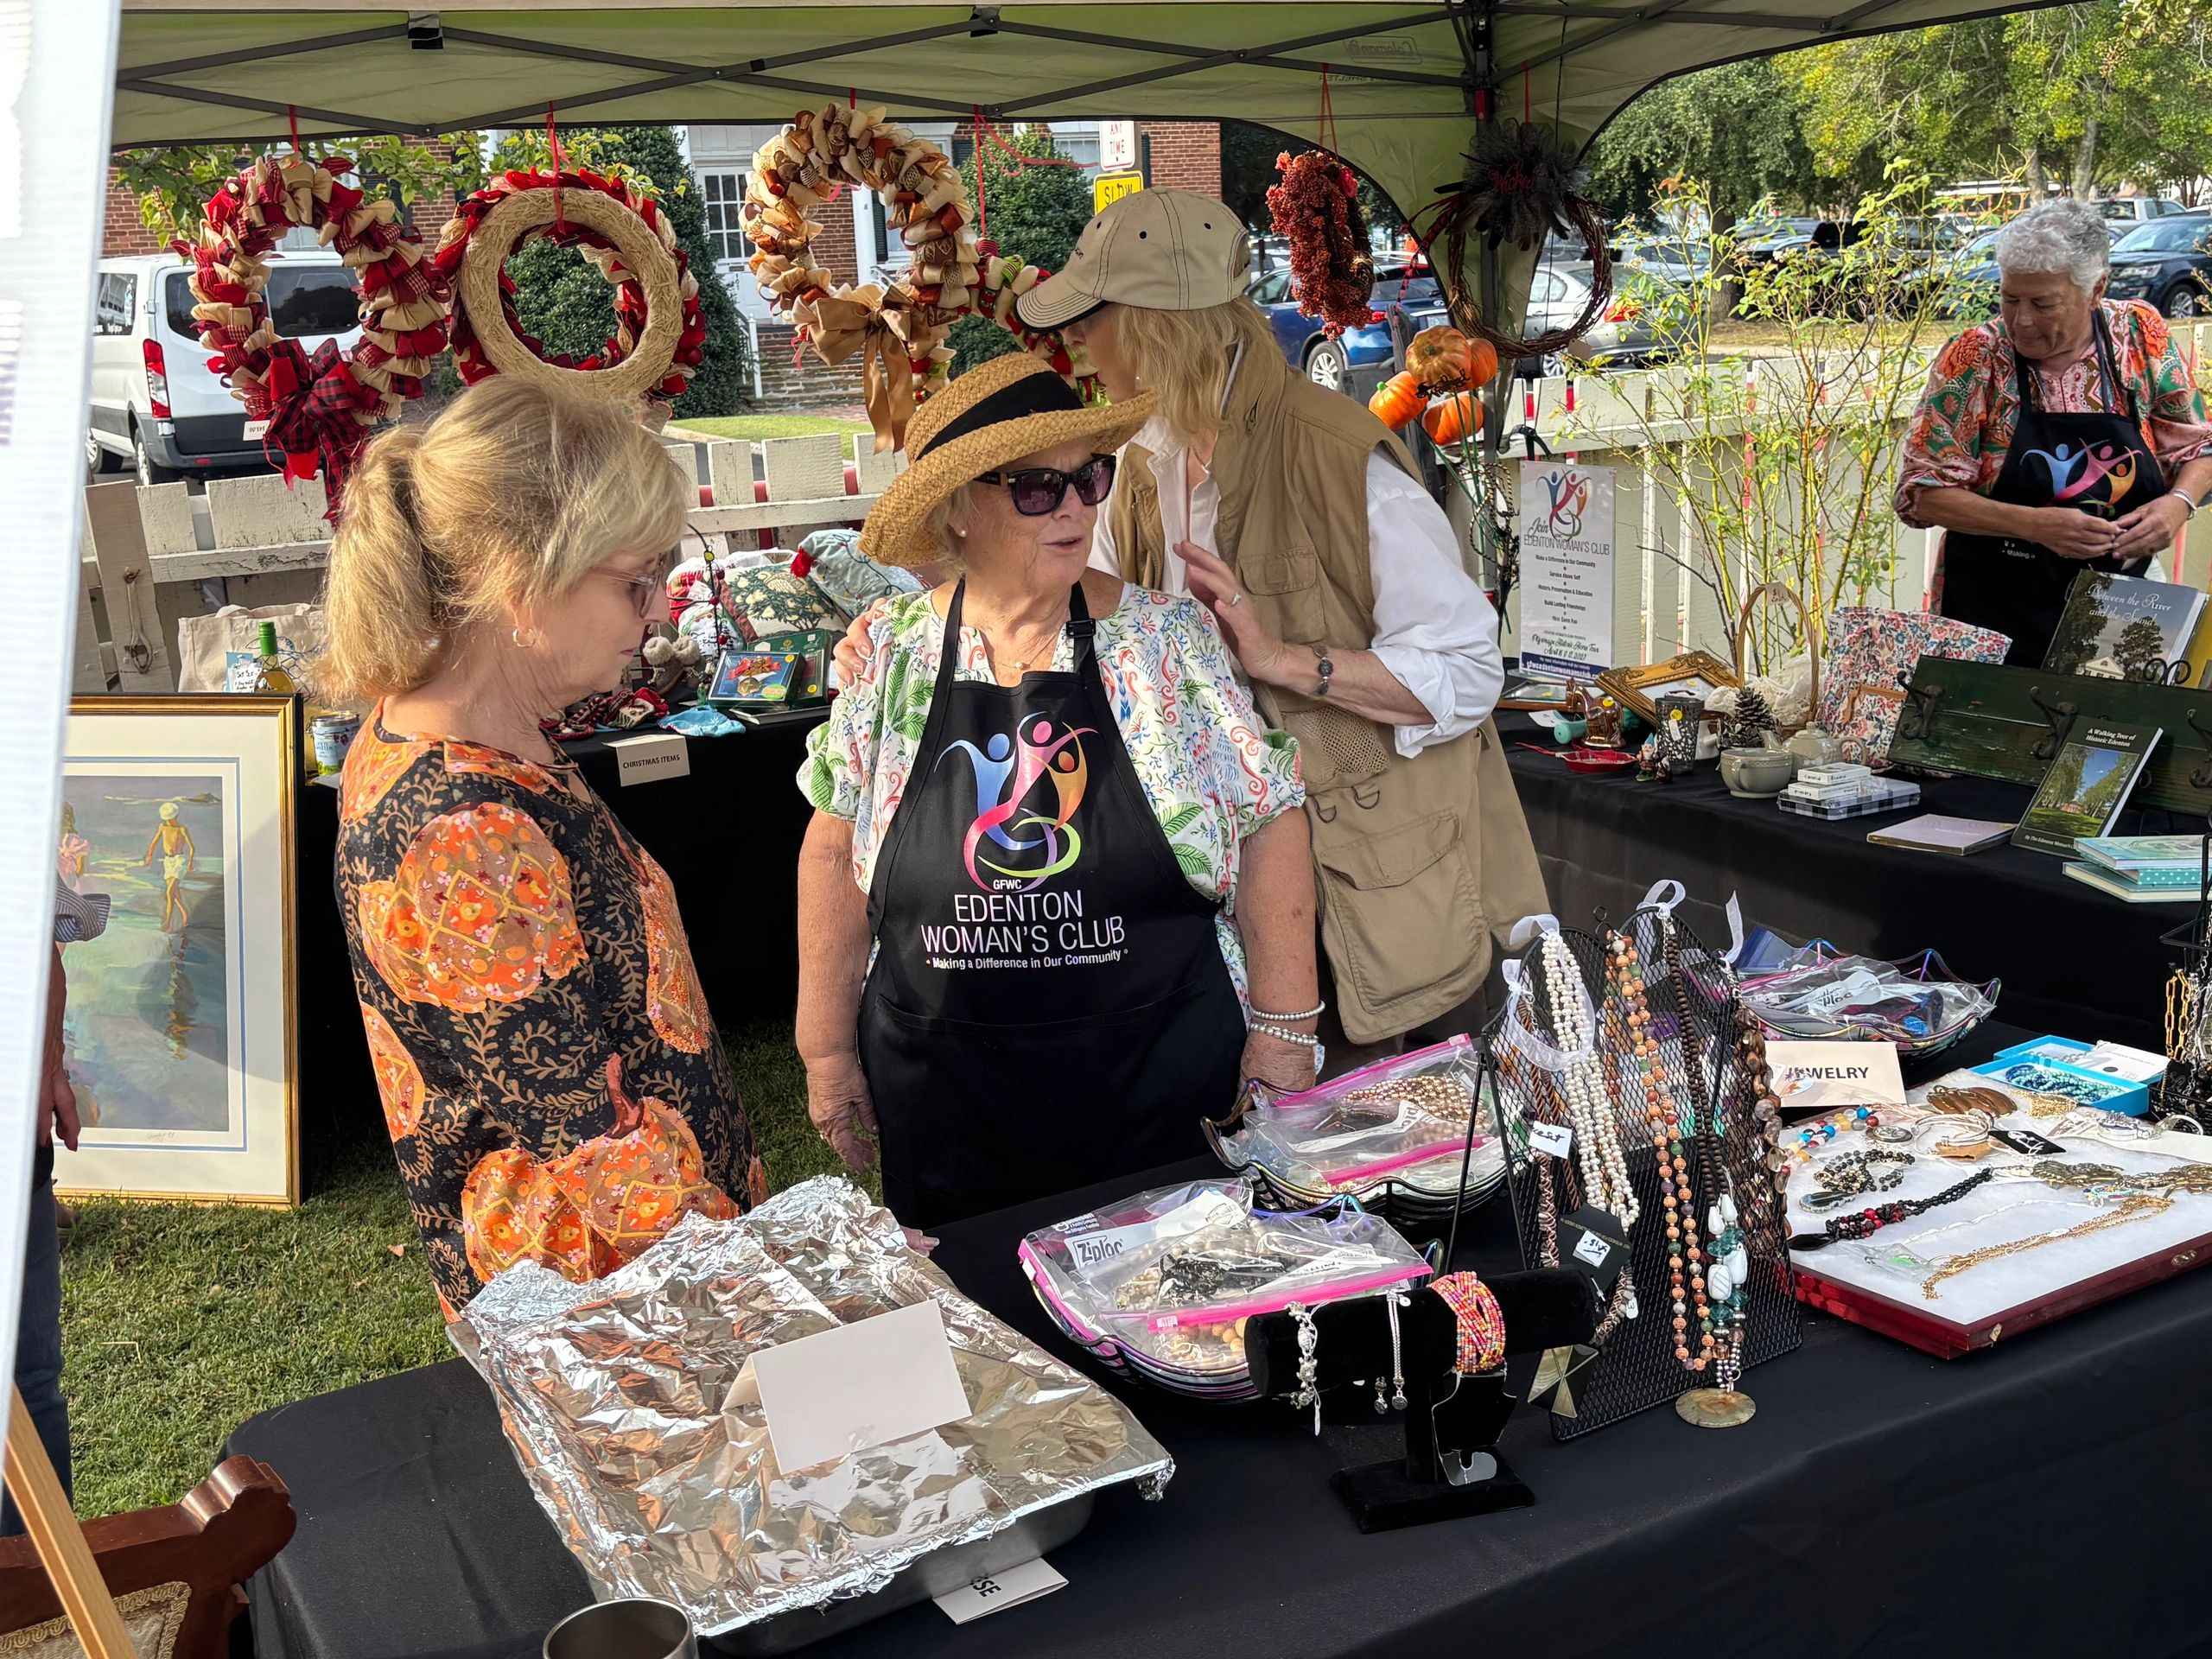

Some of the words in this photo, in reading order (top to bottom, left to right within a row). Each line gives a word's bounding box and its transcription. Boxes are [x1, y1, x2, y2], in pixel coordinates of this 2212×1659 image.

[1109, 139, 1125, 155] TIME
[1528, 517, 1548, 536] Join
[1523, 535, 1554, 549] EDENTON
[1555, 537, 1590, 553] WOMAN'S
[1591, 542, 1610, 555] CLUB
[2085, 583, 2125, 604] Between
[2126, 592, 2139, 606] the
[2141, 594, 2171, 611] River
[2089, 605, 2106, 616] and
[2107, 606, 2120, 619] the
[2122, 608, 2158, 626] Sound
[2086, 735, 2107, 744] Historic
[2107, 739, 2130, 747] Edenton
[2094, 729, 2116, 739] Walking
[623, 757, 660, 769] CHRISTMAS
[660, 754, 680, 764] ITEMS
[993, 880, 1022, 890] GFWC
[954, 890, 1083, 922] EDENTON
[921, 925, 1049, 953] WOMAN'S
[1058, 916, 1125, 950] CLUB
[932, 957, 966, 970] Making
[976, 957, 1028, 969] Difference
[1031, 957, 1040, 969] in
[1044, 956, 1062, 968] Our
[1065, 950, 1122, 965] Community
[1077, 1240, 1122, 1262] Ziploc
